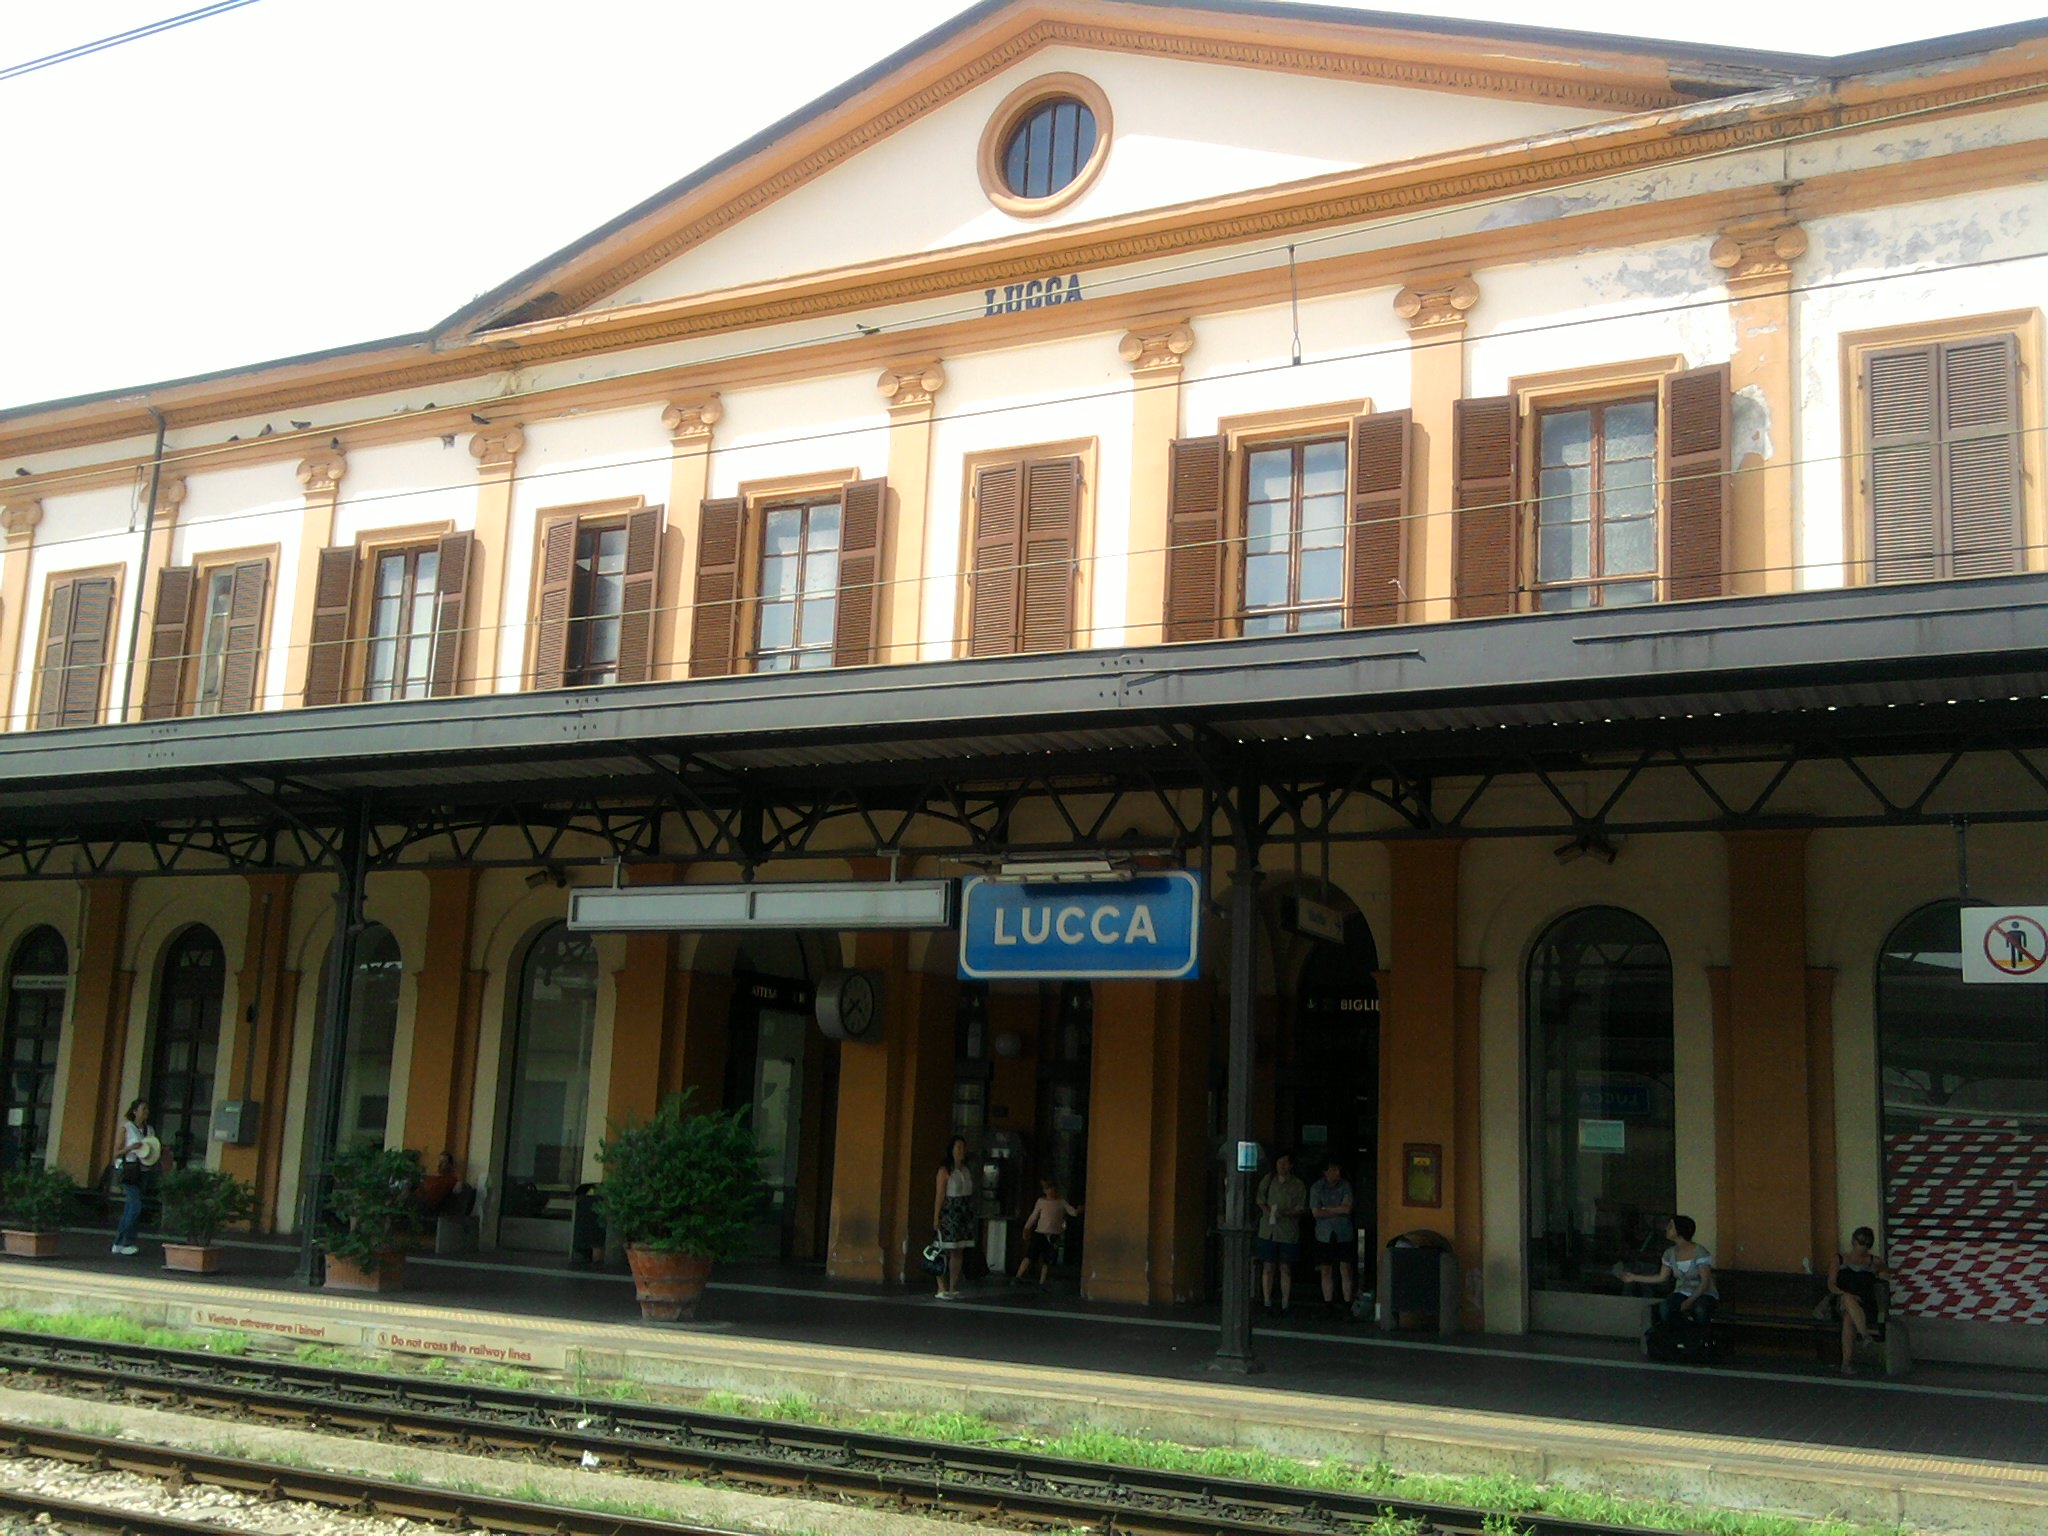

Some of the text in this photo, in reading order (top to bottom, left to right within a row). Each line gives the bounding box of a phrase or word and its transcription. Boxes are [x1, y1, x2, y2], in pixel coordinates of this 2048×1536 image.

[984, 274, 1083, 317] LUCCA
[994, 905, 1157, 945] LUCCA
[208, 1312, 238, 1326] Vietato
[239, 1319, 293, 1334] attraversare
[299, 1324, 325, 1337] binari
[391, 1334, 532, 1361] Do not cross the railway lines
